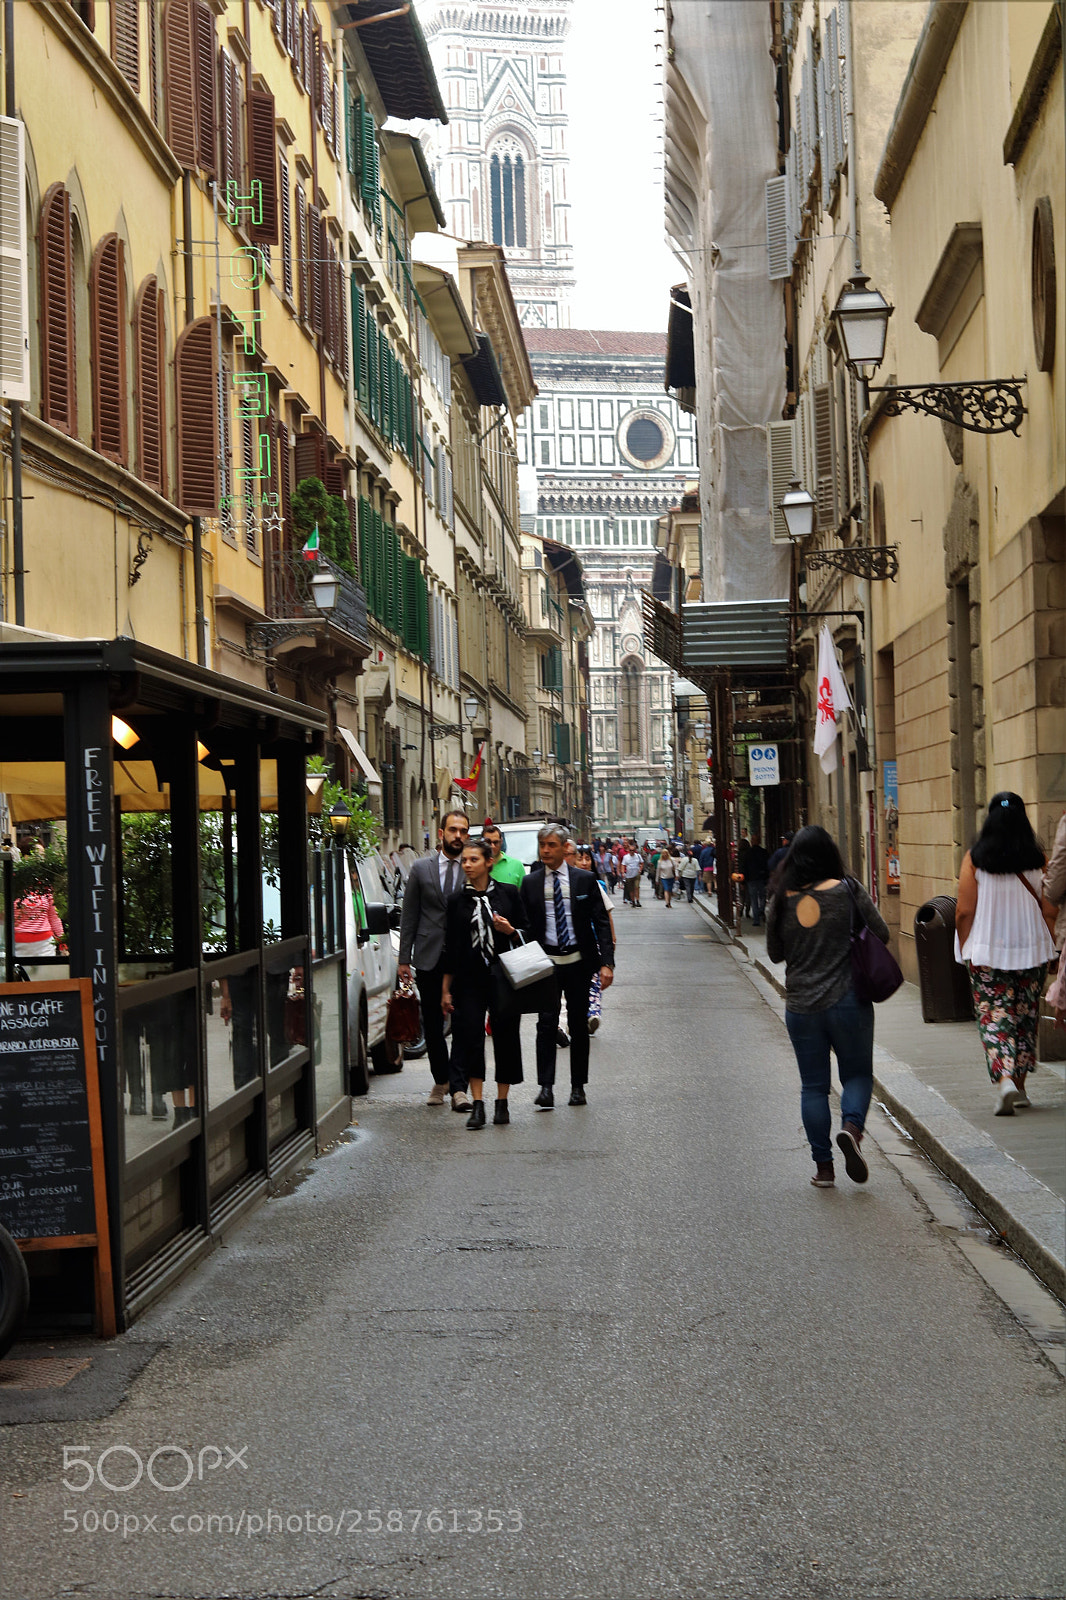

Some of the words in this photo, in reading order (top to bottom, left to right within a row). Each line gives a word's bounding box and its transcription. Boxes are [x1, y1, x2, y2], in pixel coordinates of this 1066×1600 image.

[84, 747, 102, 833] FREE
[86, 843, 106, 933] WIFI
[92, 948, 107, 985] IN
[94, 1008, 109, 1062] OUT
[29, 1185, 77, 1196] CROISSANT
